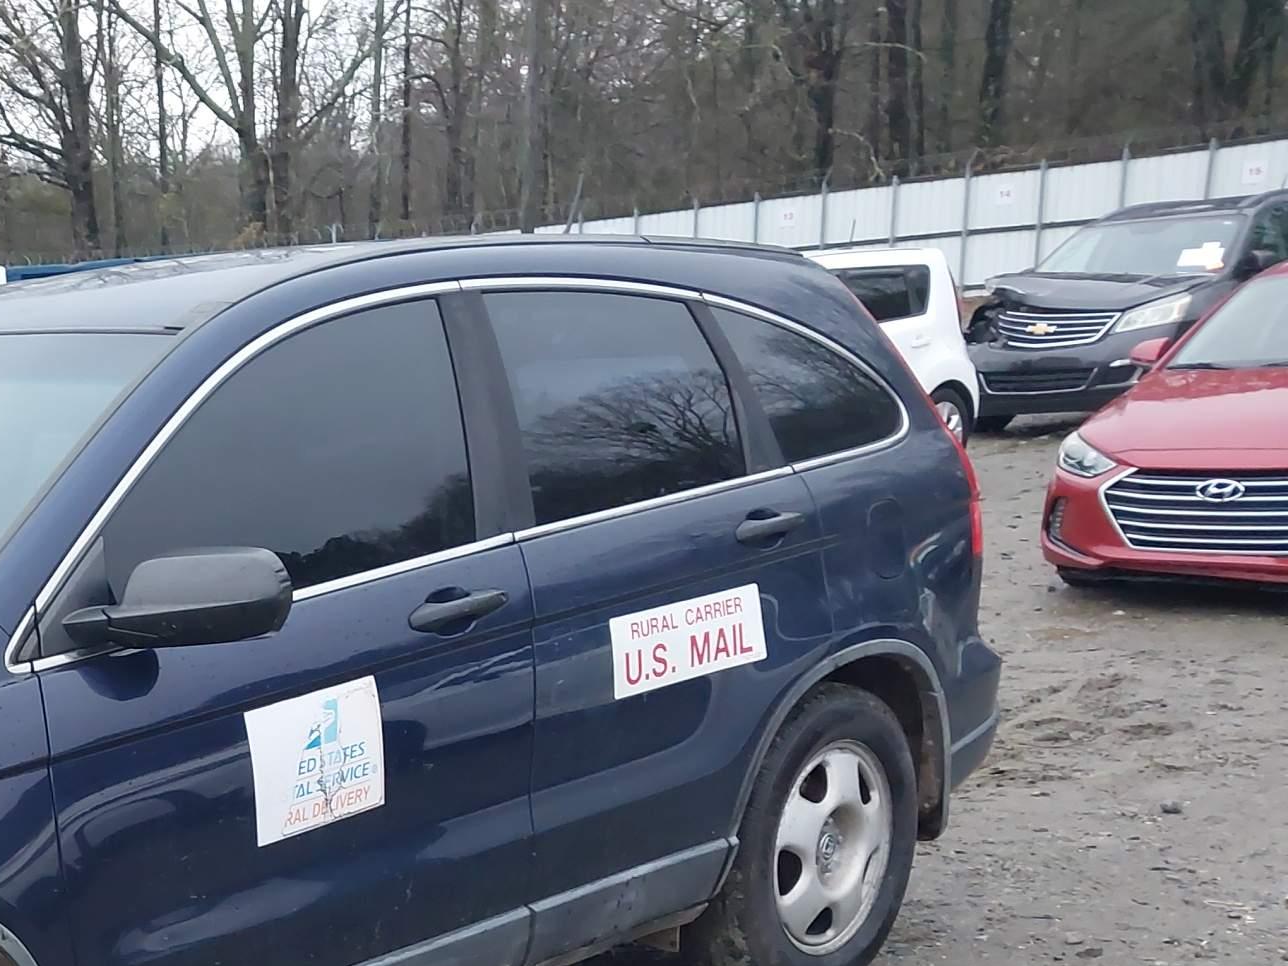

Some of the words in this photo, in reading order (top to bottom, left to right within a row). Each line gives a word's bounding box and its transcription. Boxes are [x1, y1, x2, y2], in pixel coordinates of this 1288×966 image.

[630, 613, 679, 640] RURAL
[685, 596, 743, 626] CARRIER
[625, 643, 677, 686] U.S.
[689, 623, 753, 668] MAIL
